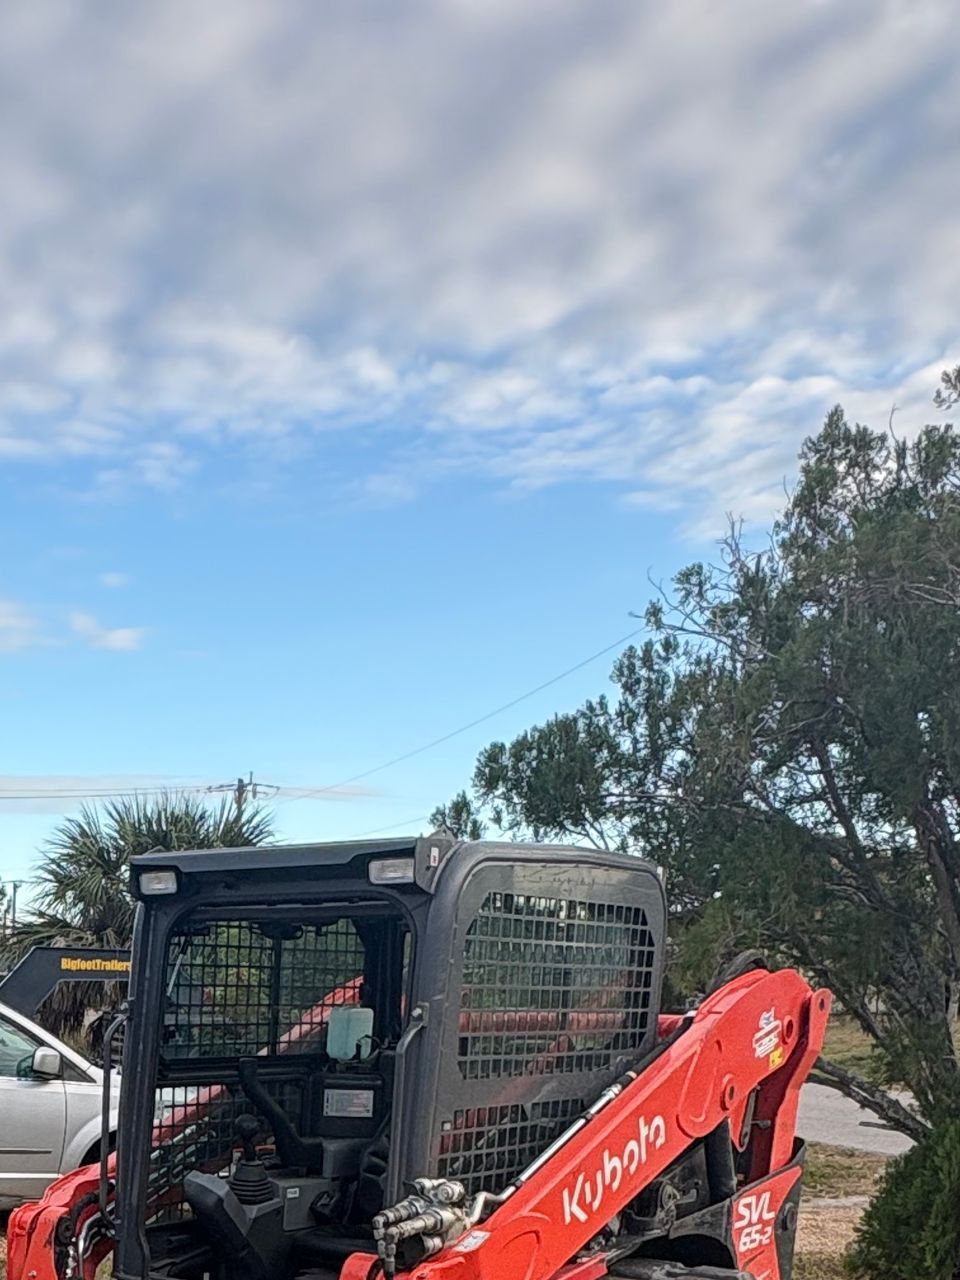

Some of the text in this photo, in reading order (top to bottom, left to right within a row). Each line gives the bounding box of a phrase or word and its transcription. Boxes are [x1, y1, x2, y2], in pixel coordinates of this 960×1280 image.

[562, 1114, 667, 1225] Kubota
[734, 1191, 776, 1229] SVL
[738, 1223, 773, 1253] 65-2
